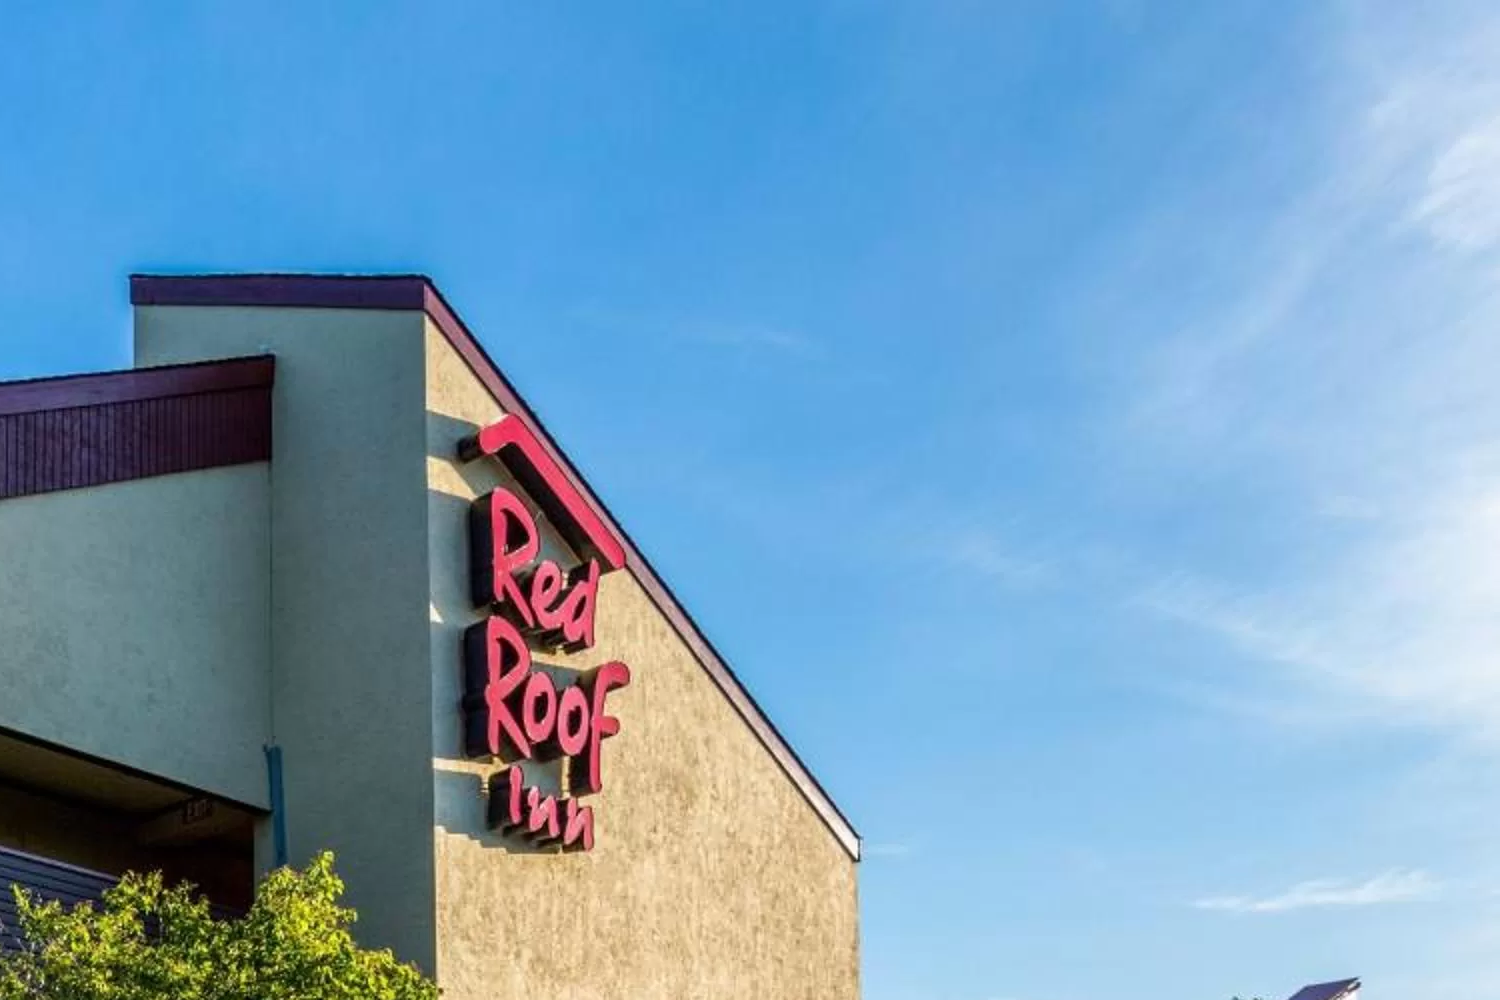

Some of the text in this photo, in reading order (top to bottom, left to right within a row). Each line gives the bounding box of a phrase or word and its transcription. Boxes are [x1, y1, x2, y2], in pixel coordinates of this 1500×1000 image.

[490, 486, 600, 648] Red
[484, 615, 631, 793] Roof
[508, 764, 595, 852] Inn
